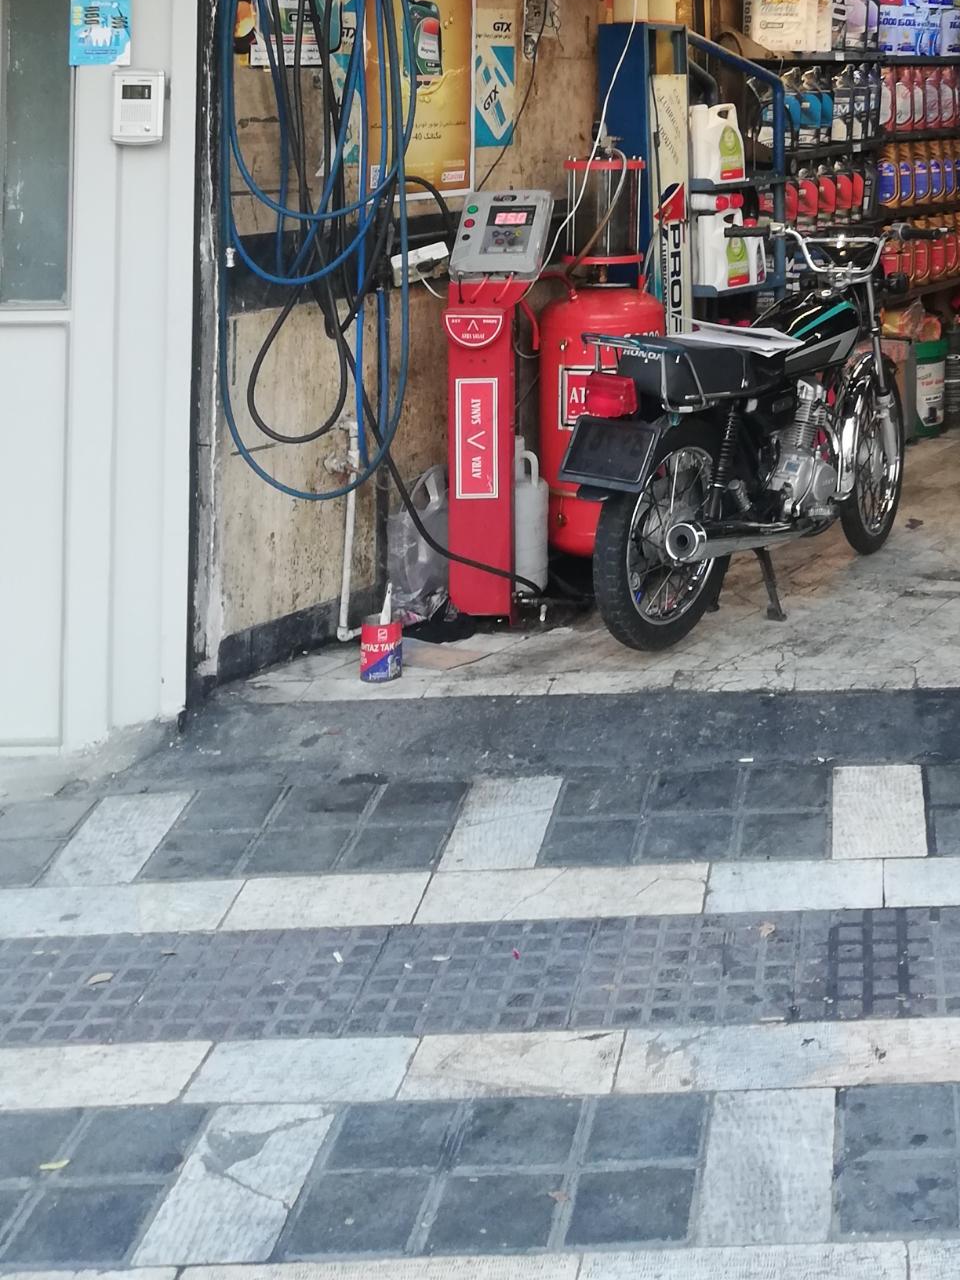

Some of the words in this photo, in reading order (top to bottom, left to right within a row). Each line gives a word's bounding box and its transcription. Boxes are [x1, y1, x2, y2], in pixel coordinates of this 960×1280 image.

[493, 21, 512, 32] GTX
[483, 85, 499, 111] GTX
[471, 398, 482, 425] SANAT
[471, 456, 482, 480] ATRA
